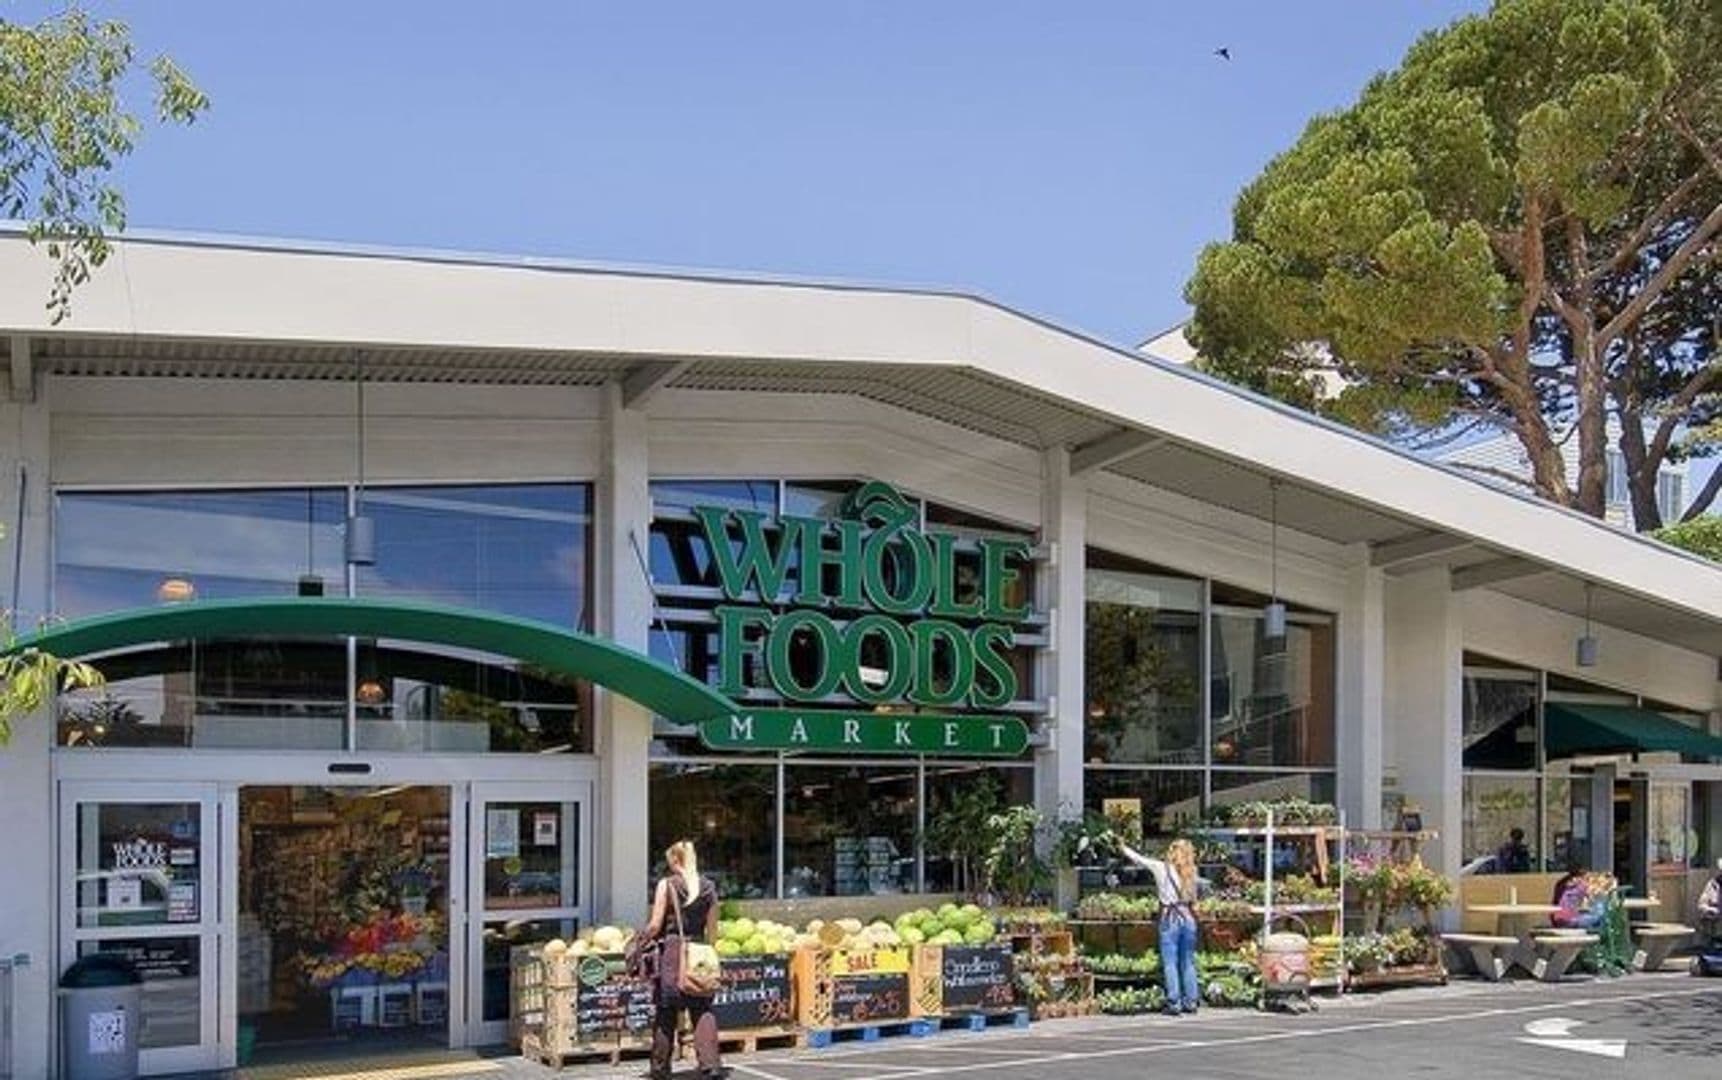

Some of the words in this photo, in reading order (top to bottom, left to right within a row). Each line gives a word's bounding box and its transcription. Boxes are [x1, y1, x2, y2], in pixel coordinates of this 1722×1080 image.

[691, 486, 1032, 621] WHOLE
[714, 604, 1017, 708] FOODS
[728, 715, 1007, 748] MARKET
[847, 953, 878, 972] SALE
